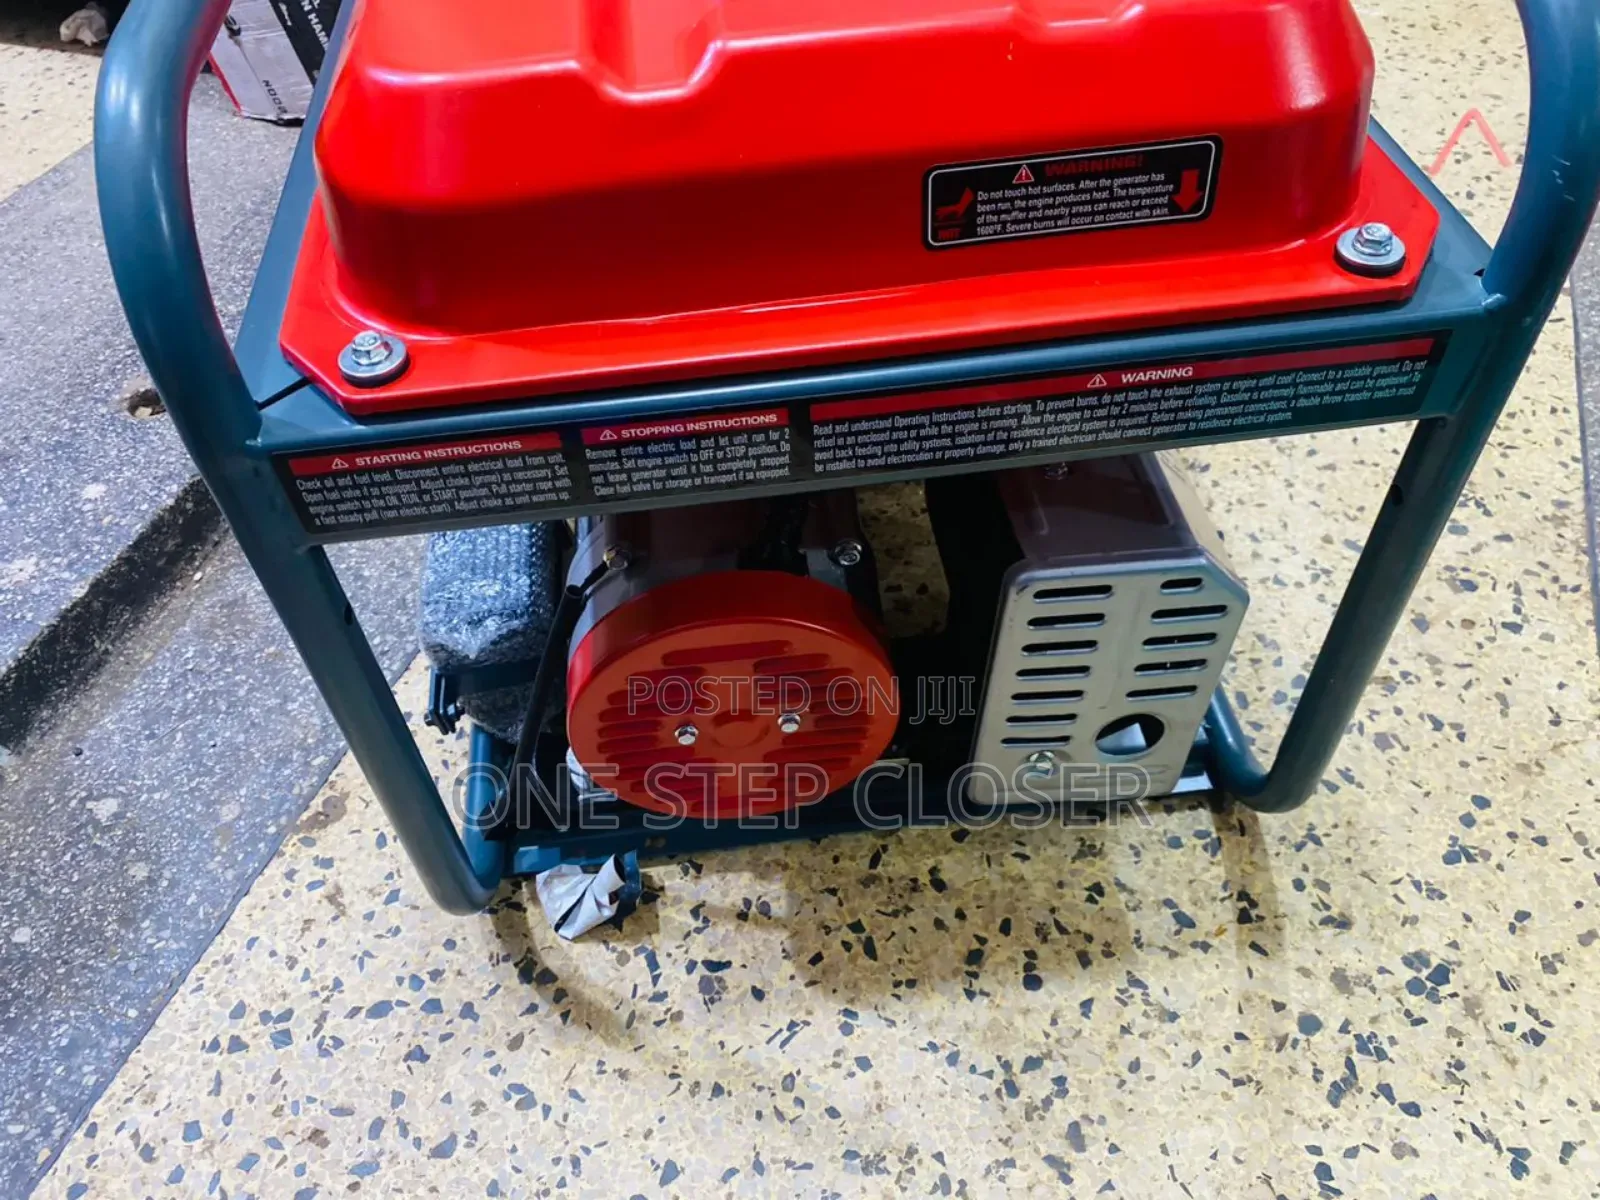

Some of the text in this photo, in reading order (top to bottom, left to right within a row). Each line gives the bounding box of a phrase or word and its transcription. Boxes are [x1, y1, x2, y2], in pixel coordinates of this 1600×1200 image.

[977, 203, 996, 212] been
[1014, 199, 1026, 208] the
[1028, 197, 1053, 208] engine
[1055, 194, 1090, 206] produces
[1112, 188, 1127, 198] The
[1128, 185, 1174, 197] temperature
[978, 172, 1165, 200] Do not touch hot surfaces. After the generator has
[976, 215, 985, 224] of
[986, 214, 999, 223] the
[1000, 211, 1027, 222] muffler
[1028, 208, 1042, 219] and
[1044, 206, 1070, 217] nearby
[1070, 206, 1091, 214] areas
[1108, 199, 1130, 210] reach
[1141, 195, 1169, 207] exceed
[1006, 223, 1032, 232] Severe
[1034, 220, 1055, 229] burns
[1057, 217, 1070, 227] will
[1070, 217, 1092, 225] occur
[1105, 211, 1133, 221] contact
[1134, 208, 1150, 218] with
[1121, 365, 1193, 383] WARNING
[620, 414, 778, 438] STOPPING INSTRUCTIONS
[355, 440, 522, 466] STARTING INSTRUCTIONS
